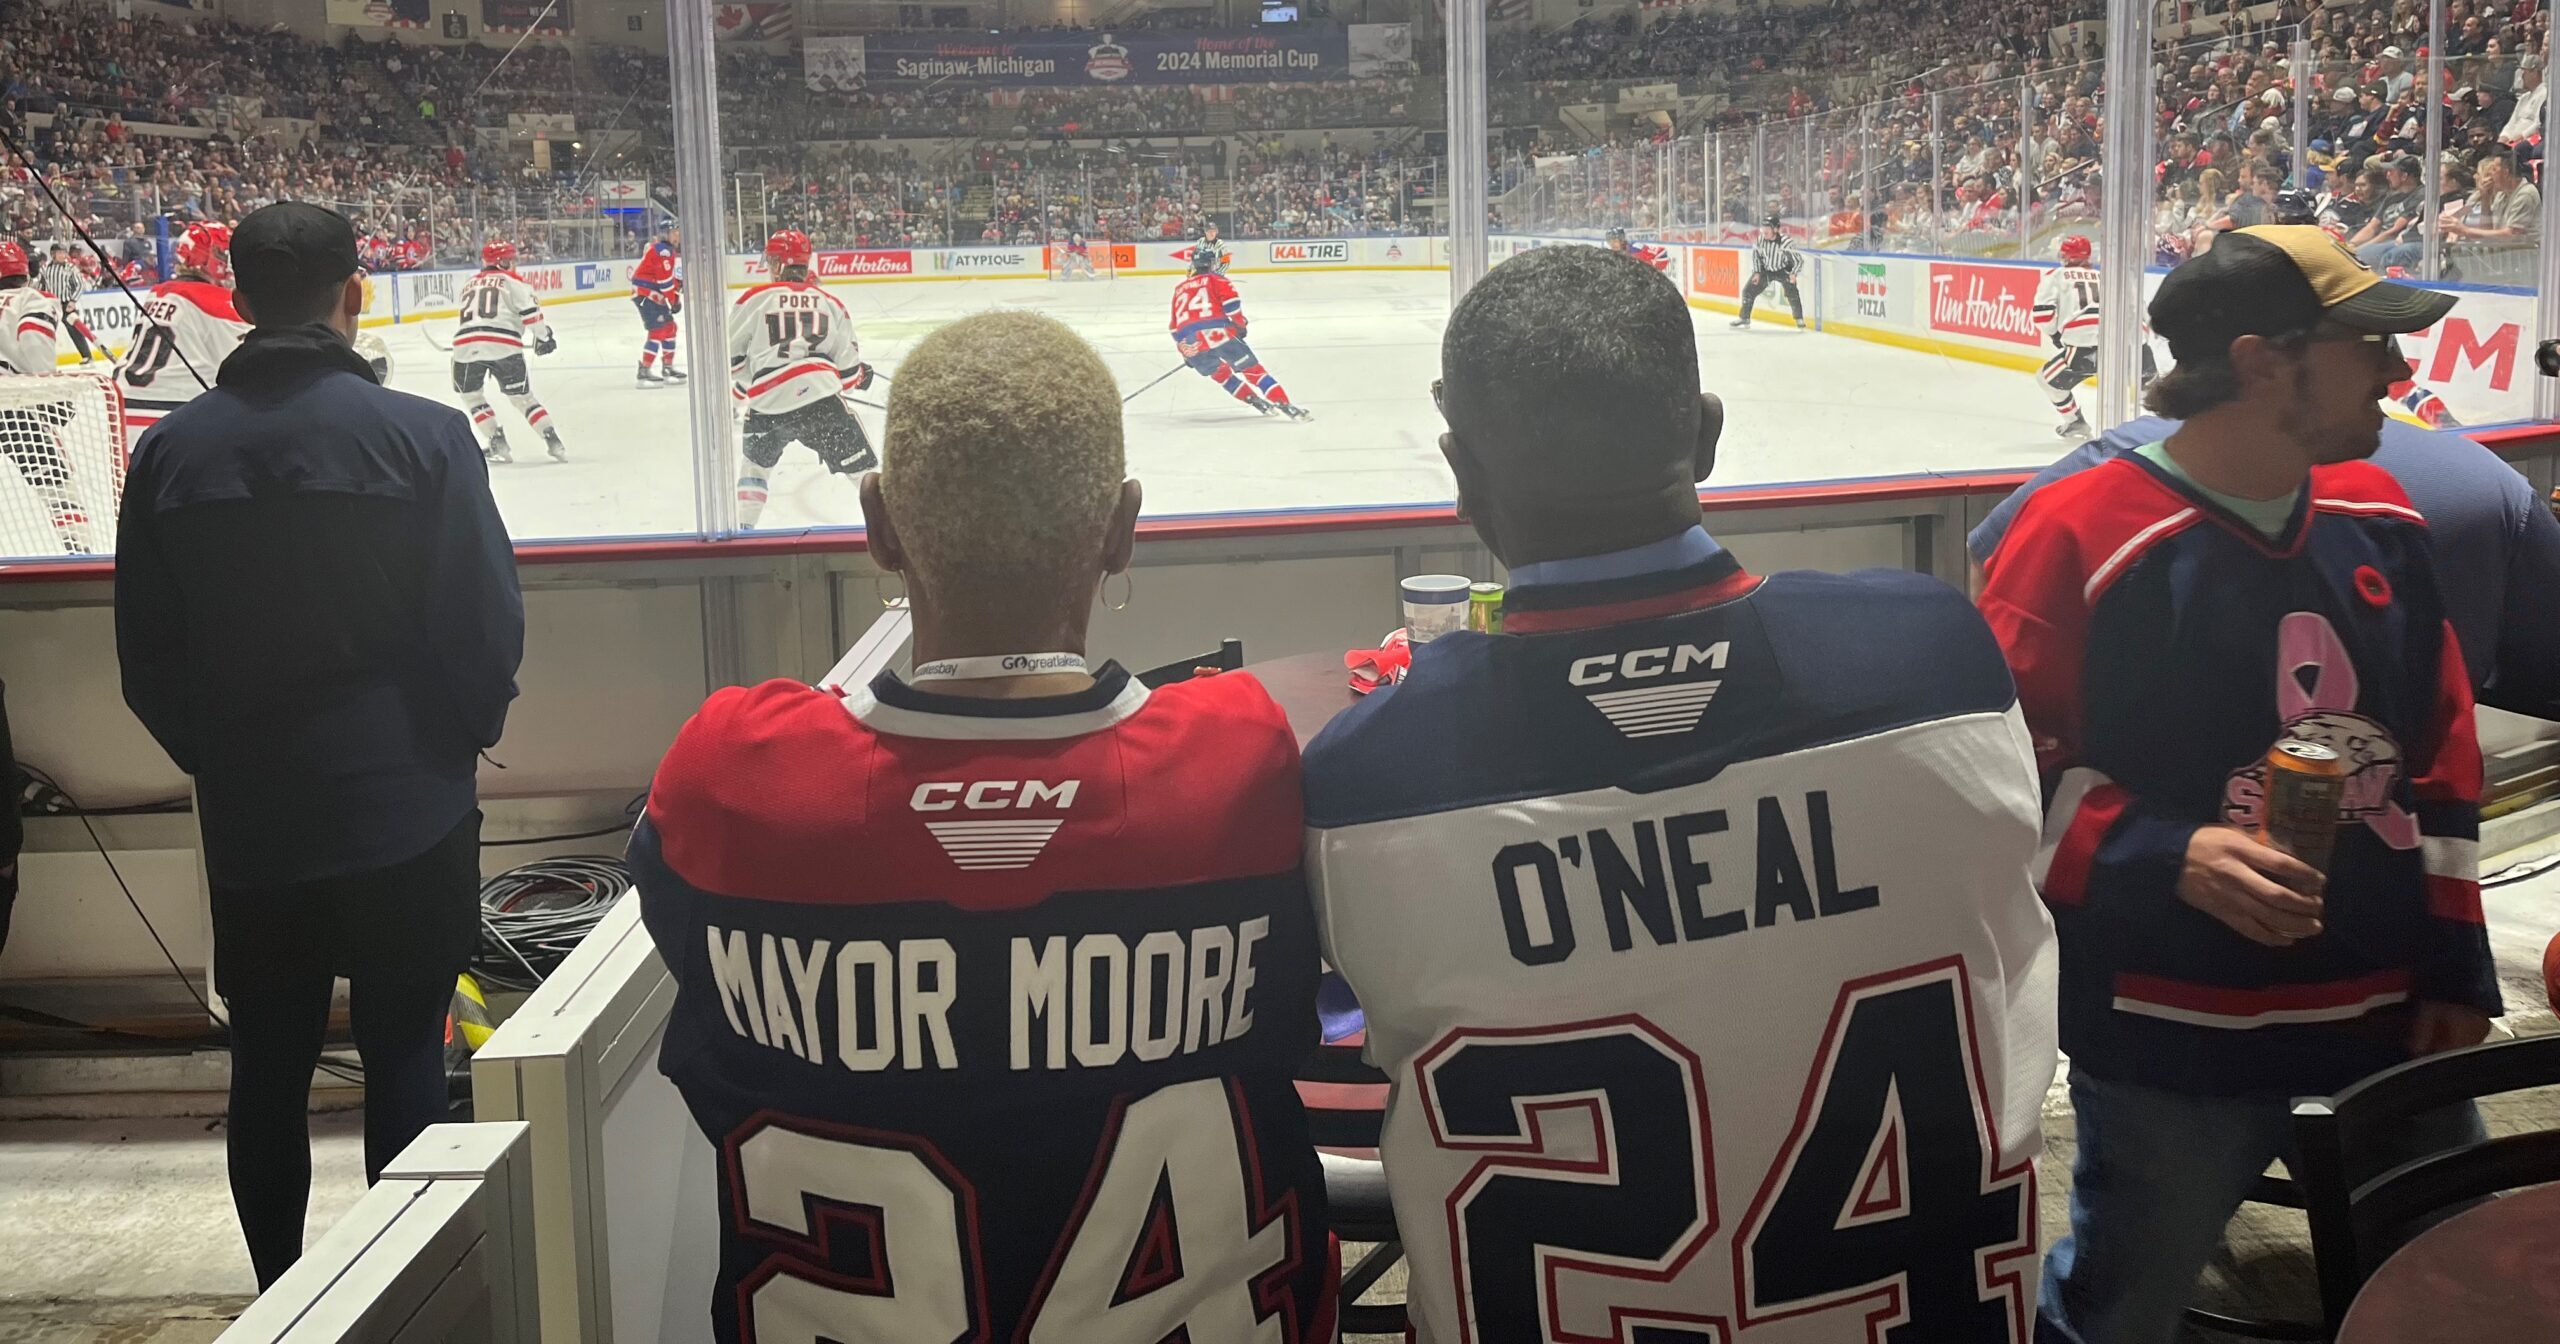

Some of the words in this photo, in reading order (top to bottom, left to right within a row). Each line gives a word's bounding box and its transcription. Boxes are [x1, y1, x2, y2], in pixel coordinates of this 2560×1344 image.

[1195, 36, 1233, 51] Home
[1238, 36, 1253, 51] of
[1253, 35, 1277, 50] the
[896, 57, 973, 79] Saginaw,
[977, 56, 1055, 77] Michigan
[1156, 51, 1201, 71] 2024
[1205, 50, 1283, 69] Memorial
[1287, 49, 1319, 70] Cup
[663, 260, 671, 271] 6
[820, 255, 848, 275] Tim
[849, 253, 909, 274] Hortons
[955, 253, 1025, 267] ATYPIQUE
[550, 269, 563, 289] OIL
[460, 286, 500, 326] 20
[779, 294, 820, 309] PORT
[1175, 286, 1213, 325] 24
[1857, 297, 1887, 318] PIZZA
[1932, 274, 1963, 325] Tim
[1965, 273, 2035, 337] Hortons
[1567, 641, 1731, 686] CCM
[909, 780, 1081, 811] CCM
[1491, 790, 1880, 967] O'NEAL
[707, 924, 959, 1072] MAYOR
[1010, 914, 1270, 1071] MOORE
[1414, 953, 2040, 1344] 24
[724, 1076, 1298, 1344] 24
